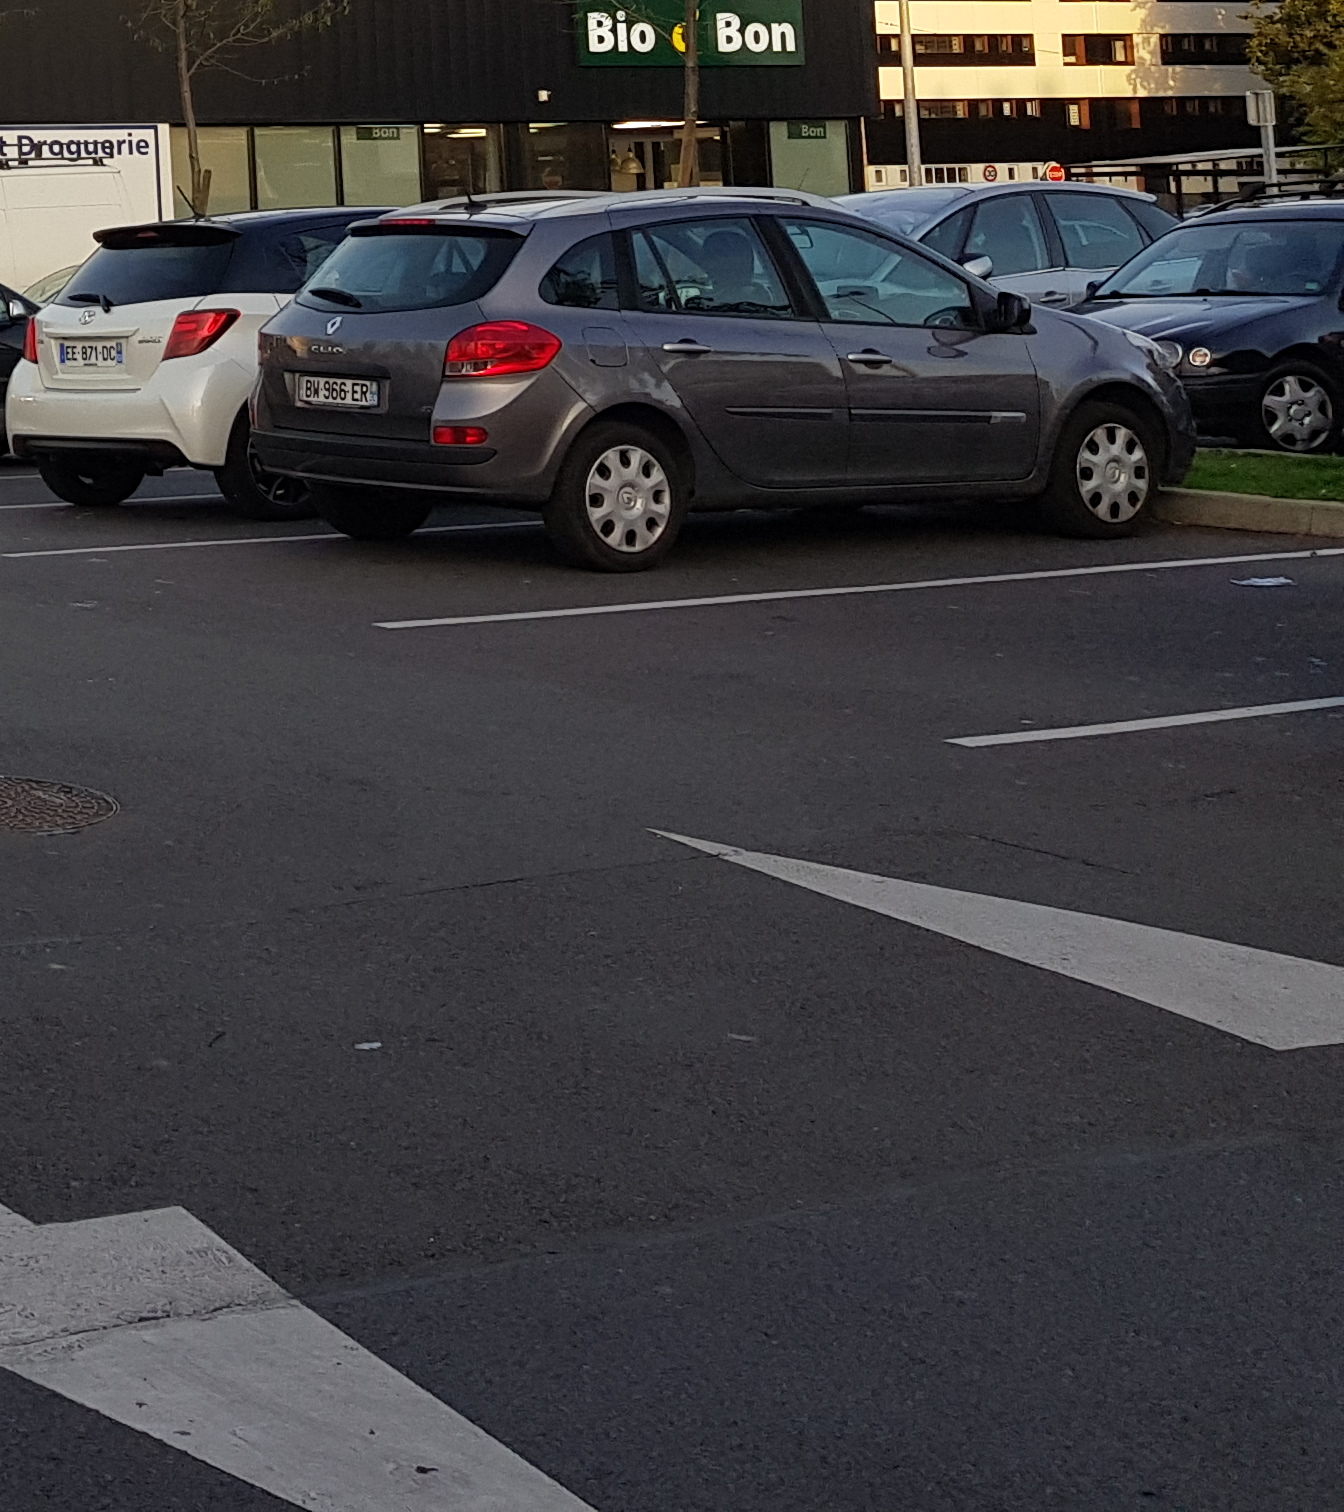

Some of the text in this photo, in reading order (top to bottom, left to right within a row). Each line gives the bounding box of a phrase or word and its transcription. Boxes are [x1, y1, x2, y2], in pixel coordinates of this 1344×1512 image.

[587, 11, 656, 53] Bio
[716, 12, 796, 53] Bon
[801, 125, 825, 137] Bon
[17, 132, 150, 162] Droguerie
[305, 379, 369, 403] BW-966-ER
